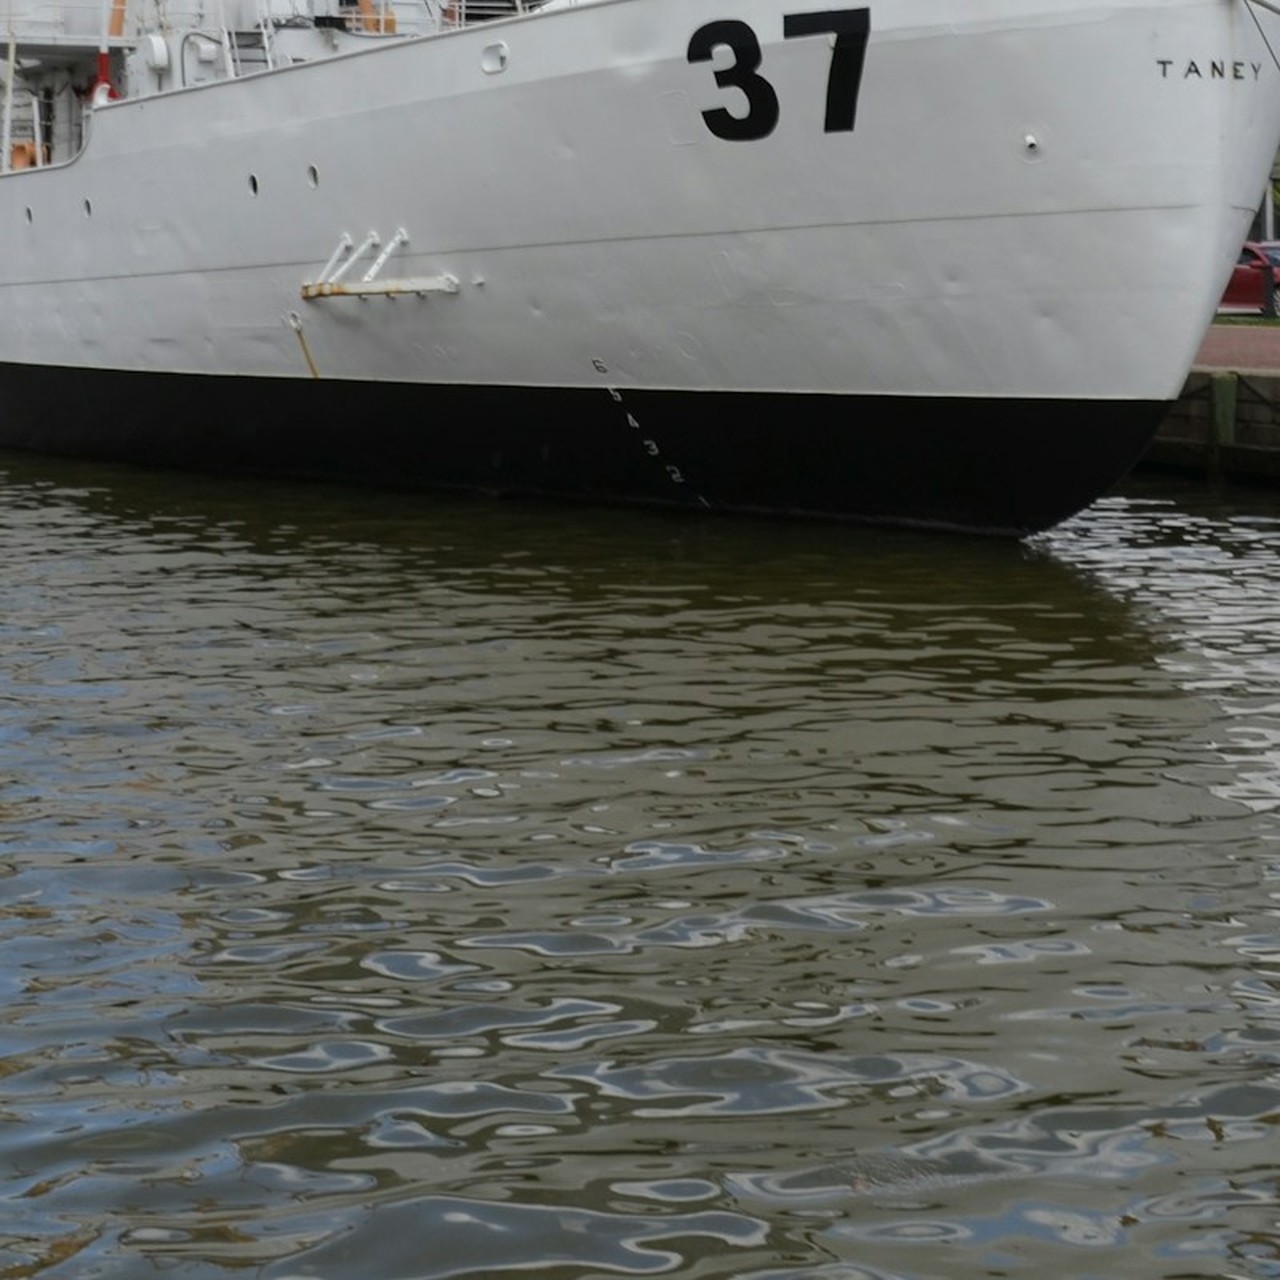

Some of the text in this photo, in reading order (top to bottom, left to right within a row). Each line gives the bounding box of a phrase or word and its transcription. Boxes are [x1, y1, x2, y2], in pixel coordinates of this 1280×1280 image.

[686, 7, 870, 142] 37
[1156, 60, 1262, 81] TANEY
[591, 358, 609, 374] 6
[643, 440, 660, 456] 3
[666, 465, 685, 483] 2
